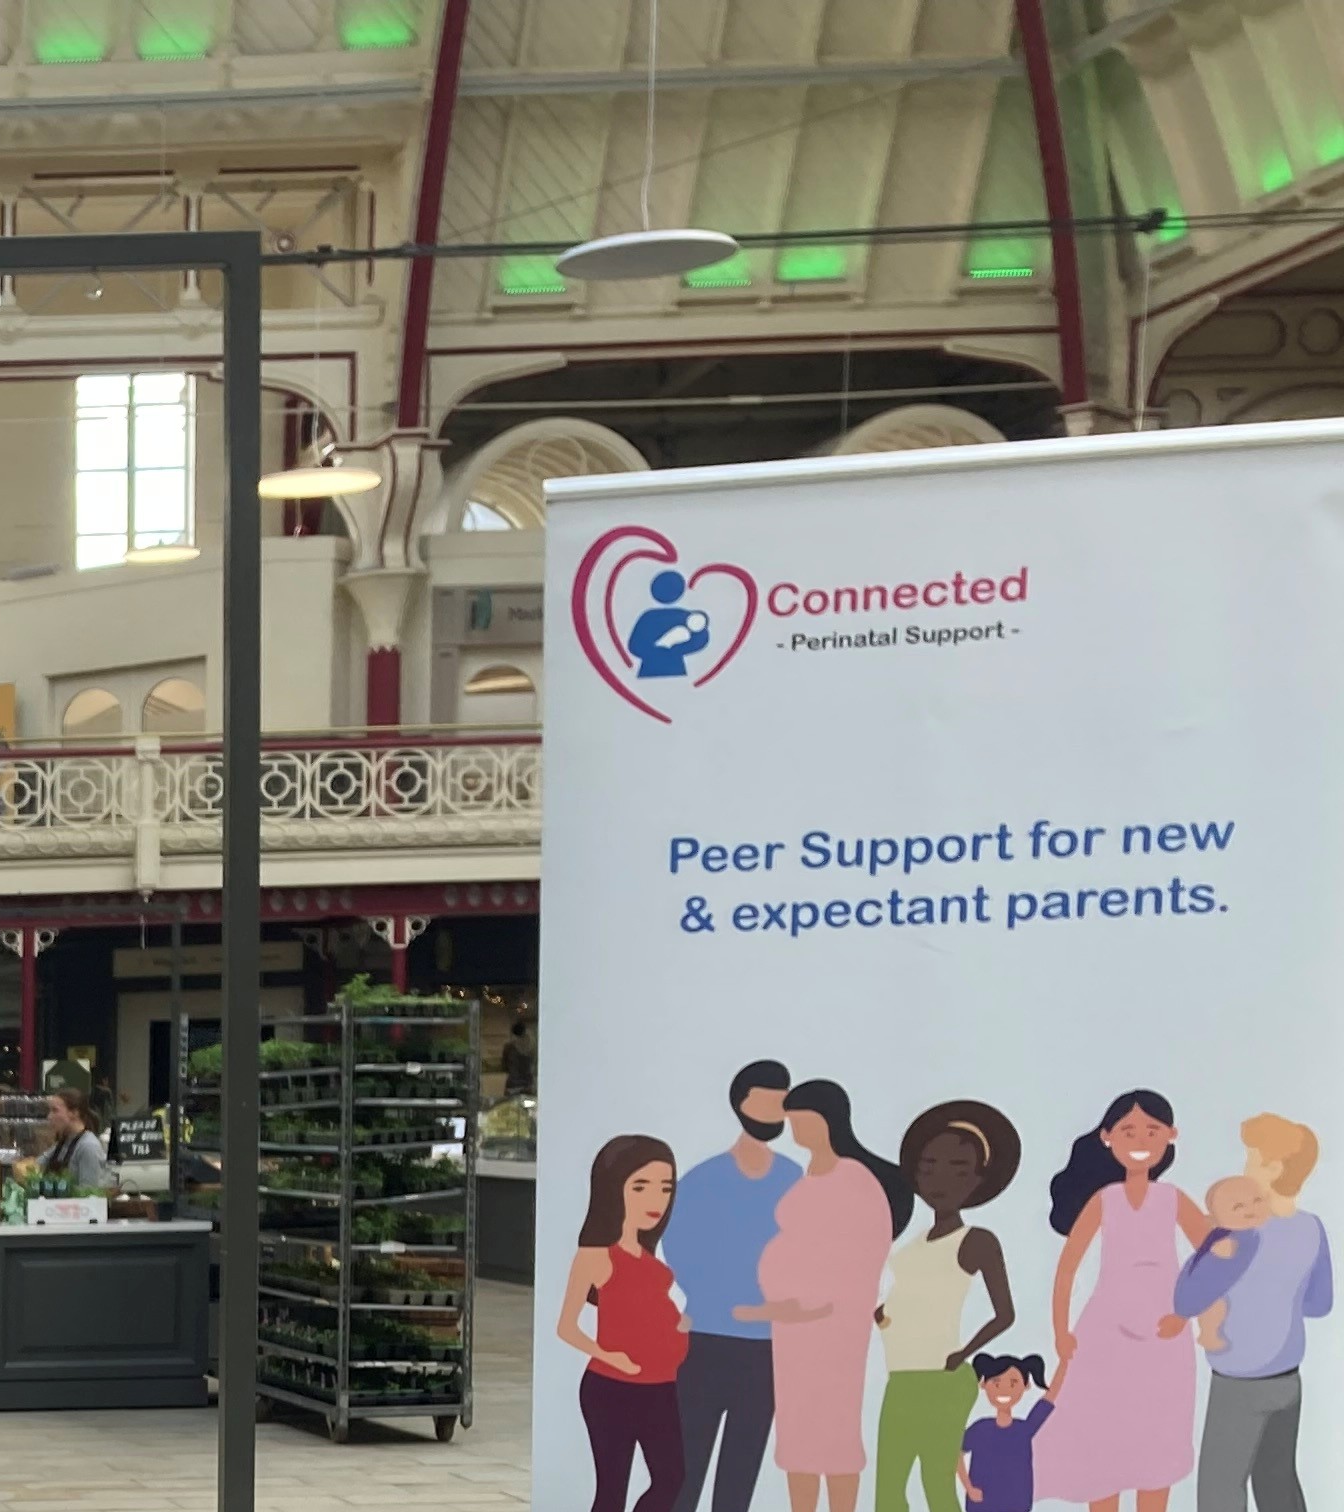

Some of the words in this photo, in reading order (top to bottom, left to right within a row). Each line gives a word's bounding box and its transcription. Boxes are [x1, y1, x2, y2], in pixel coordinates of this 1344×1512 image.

[767, 566, 1028, 618] Connected
[791, 627, 898, 652] Perinatal
[905, 621, 1005, 647] Support
[669, 837, 786, 875] Peer
[800, 823, 1015, 877] Support
[1028, 820, 1106, 860] for
[1122, 821, 1235, 855] new
[679, 895, 715, 934] &
[732, 885, 991, 938] expectant
[1007, 877, 1228, 930] parents.
